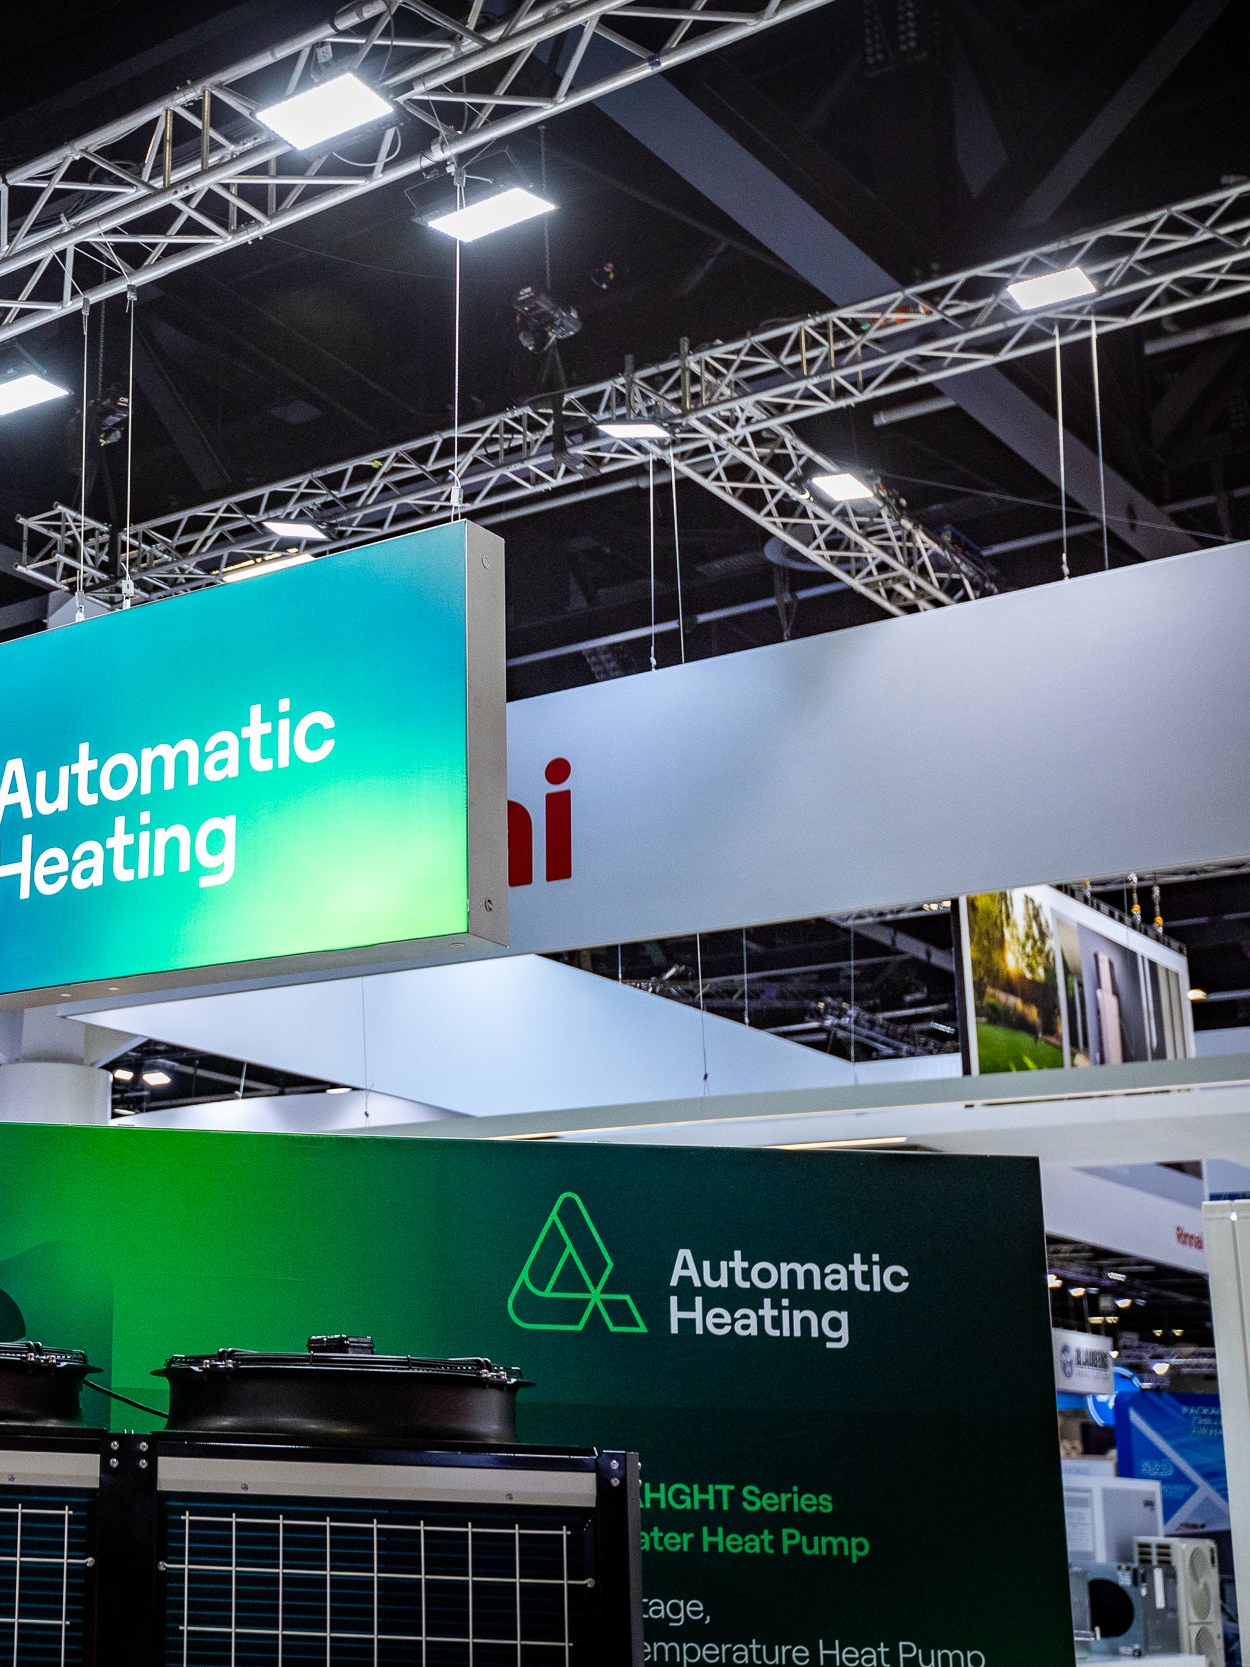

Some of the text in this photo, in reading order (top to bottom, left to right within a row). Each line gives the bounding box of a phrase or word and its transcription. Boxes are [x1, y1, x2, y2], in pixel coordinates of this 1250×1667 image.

[669, 1248, 910, 1293] Automatic
[669, 1296, 850, 1349] Heating
[640, 1482, 834, 1513] HGHT Series
[702, 1526, 775, 1554] Heat
[782, 1528, 871, 1563] Pump
[819, 1639, 891, 1667] Heat
[899, 1641, 986, 1667] Pump
